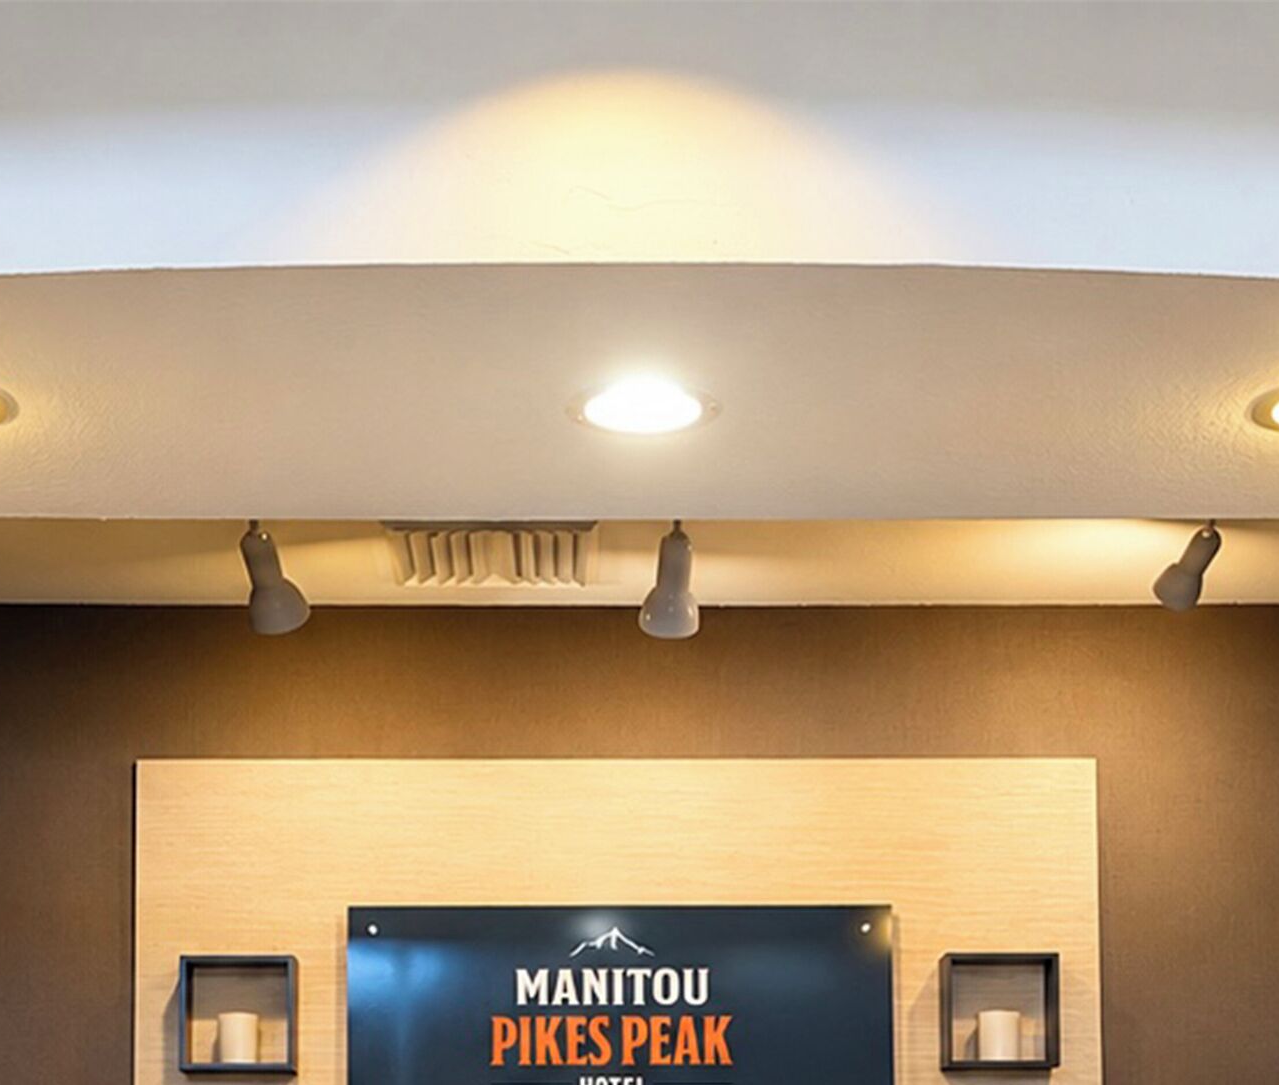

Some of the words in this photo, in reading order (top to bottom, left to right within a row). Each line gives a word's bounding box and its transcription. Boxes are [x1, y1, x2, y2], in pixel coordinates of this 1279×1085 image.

[516, 968, 709, 1005] MANITOU
[490, 1015, 612, 1065] PIKES
[621, 1015, 734, 1065] PEAK
